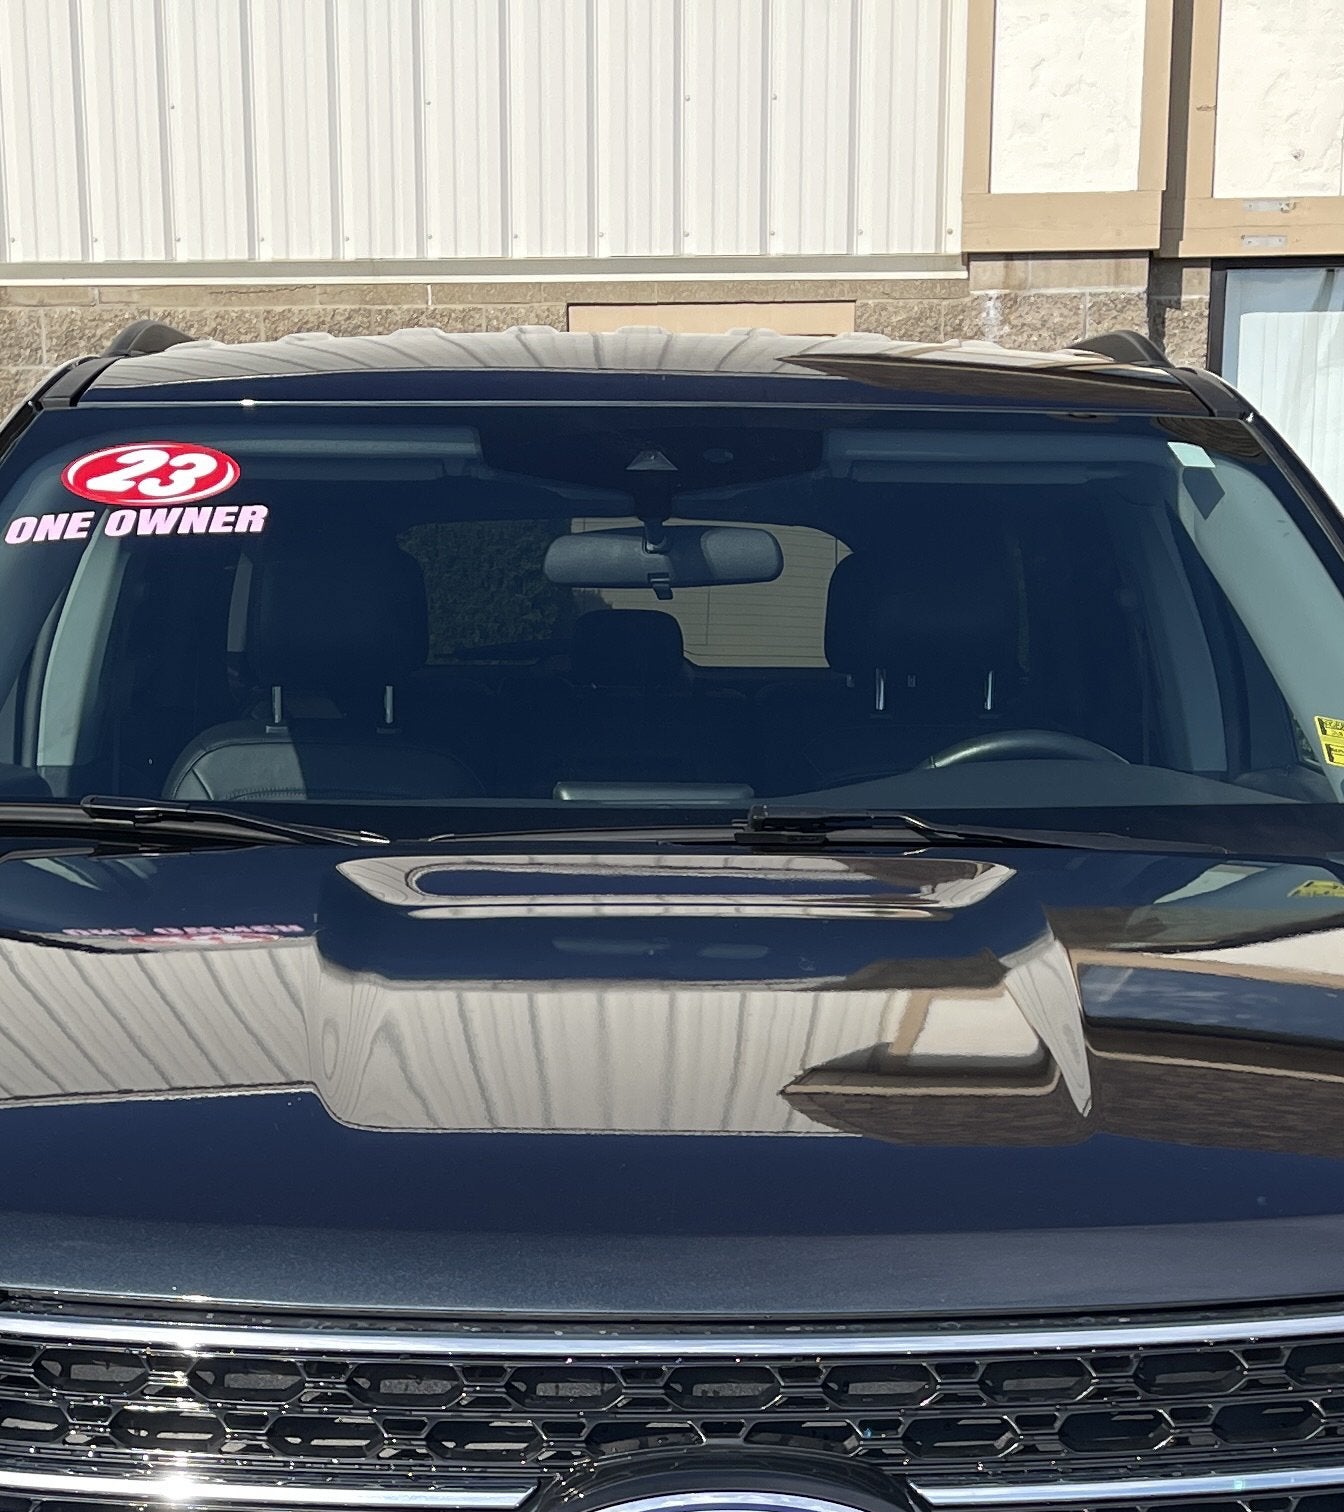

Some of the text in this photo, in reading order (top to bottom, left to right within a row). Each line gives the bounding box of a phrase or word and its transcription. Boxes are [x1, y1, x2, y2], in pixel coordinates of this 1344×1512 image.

[85, 448, 219, 498] 23
[5, 504, 269, 545] ONE OWNER
